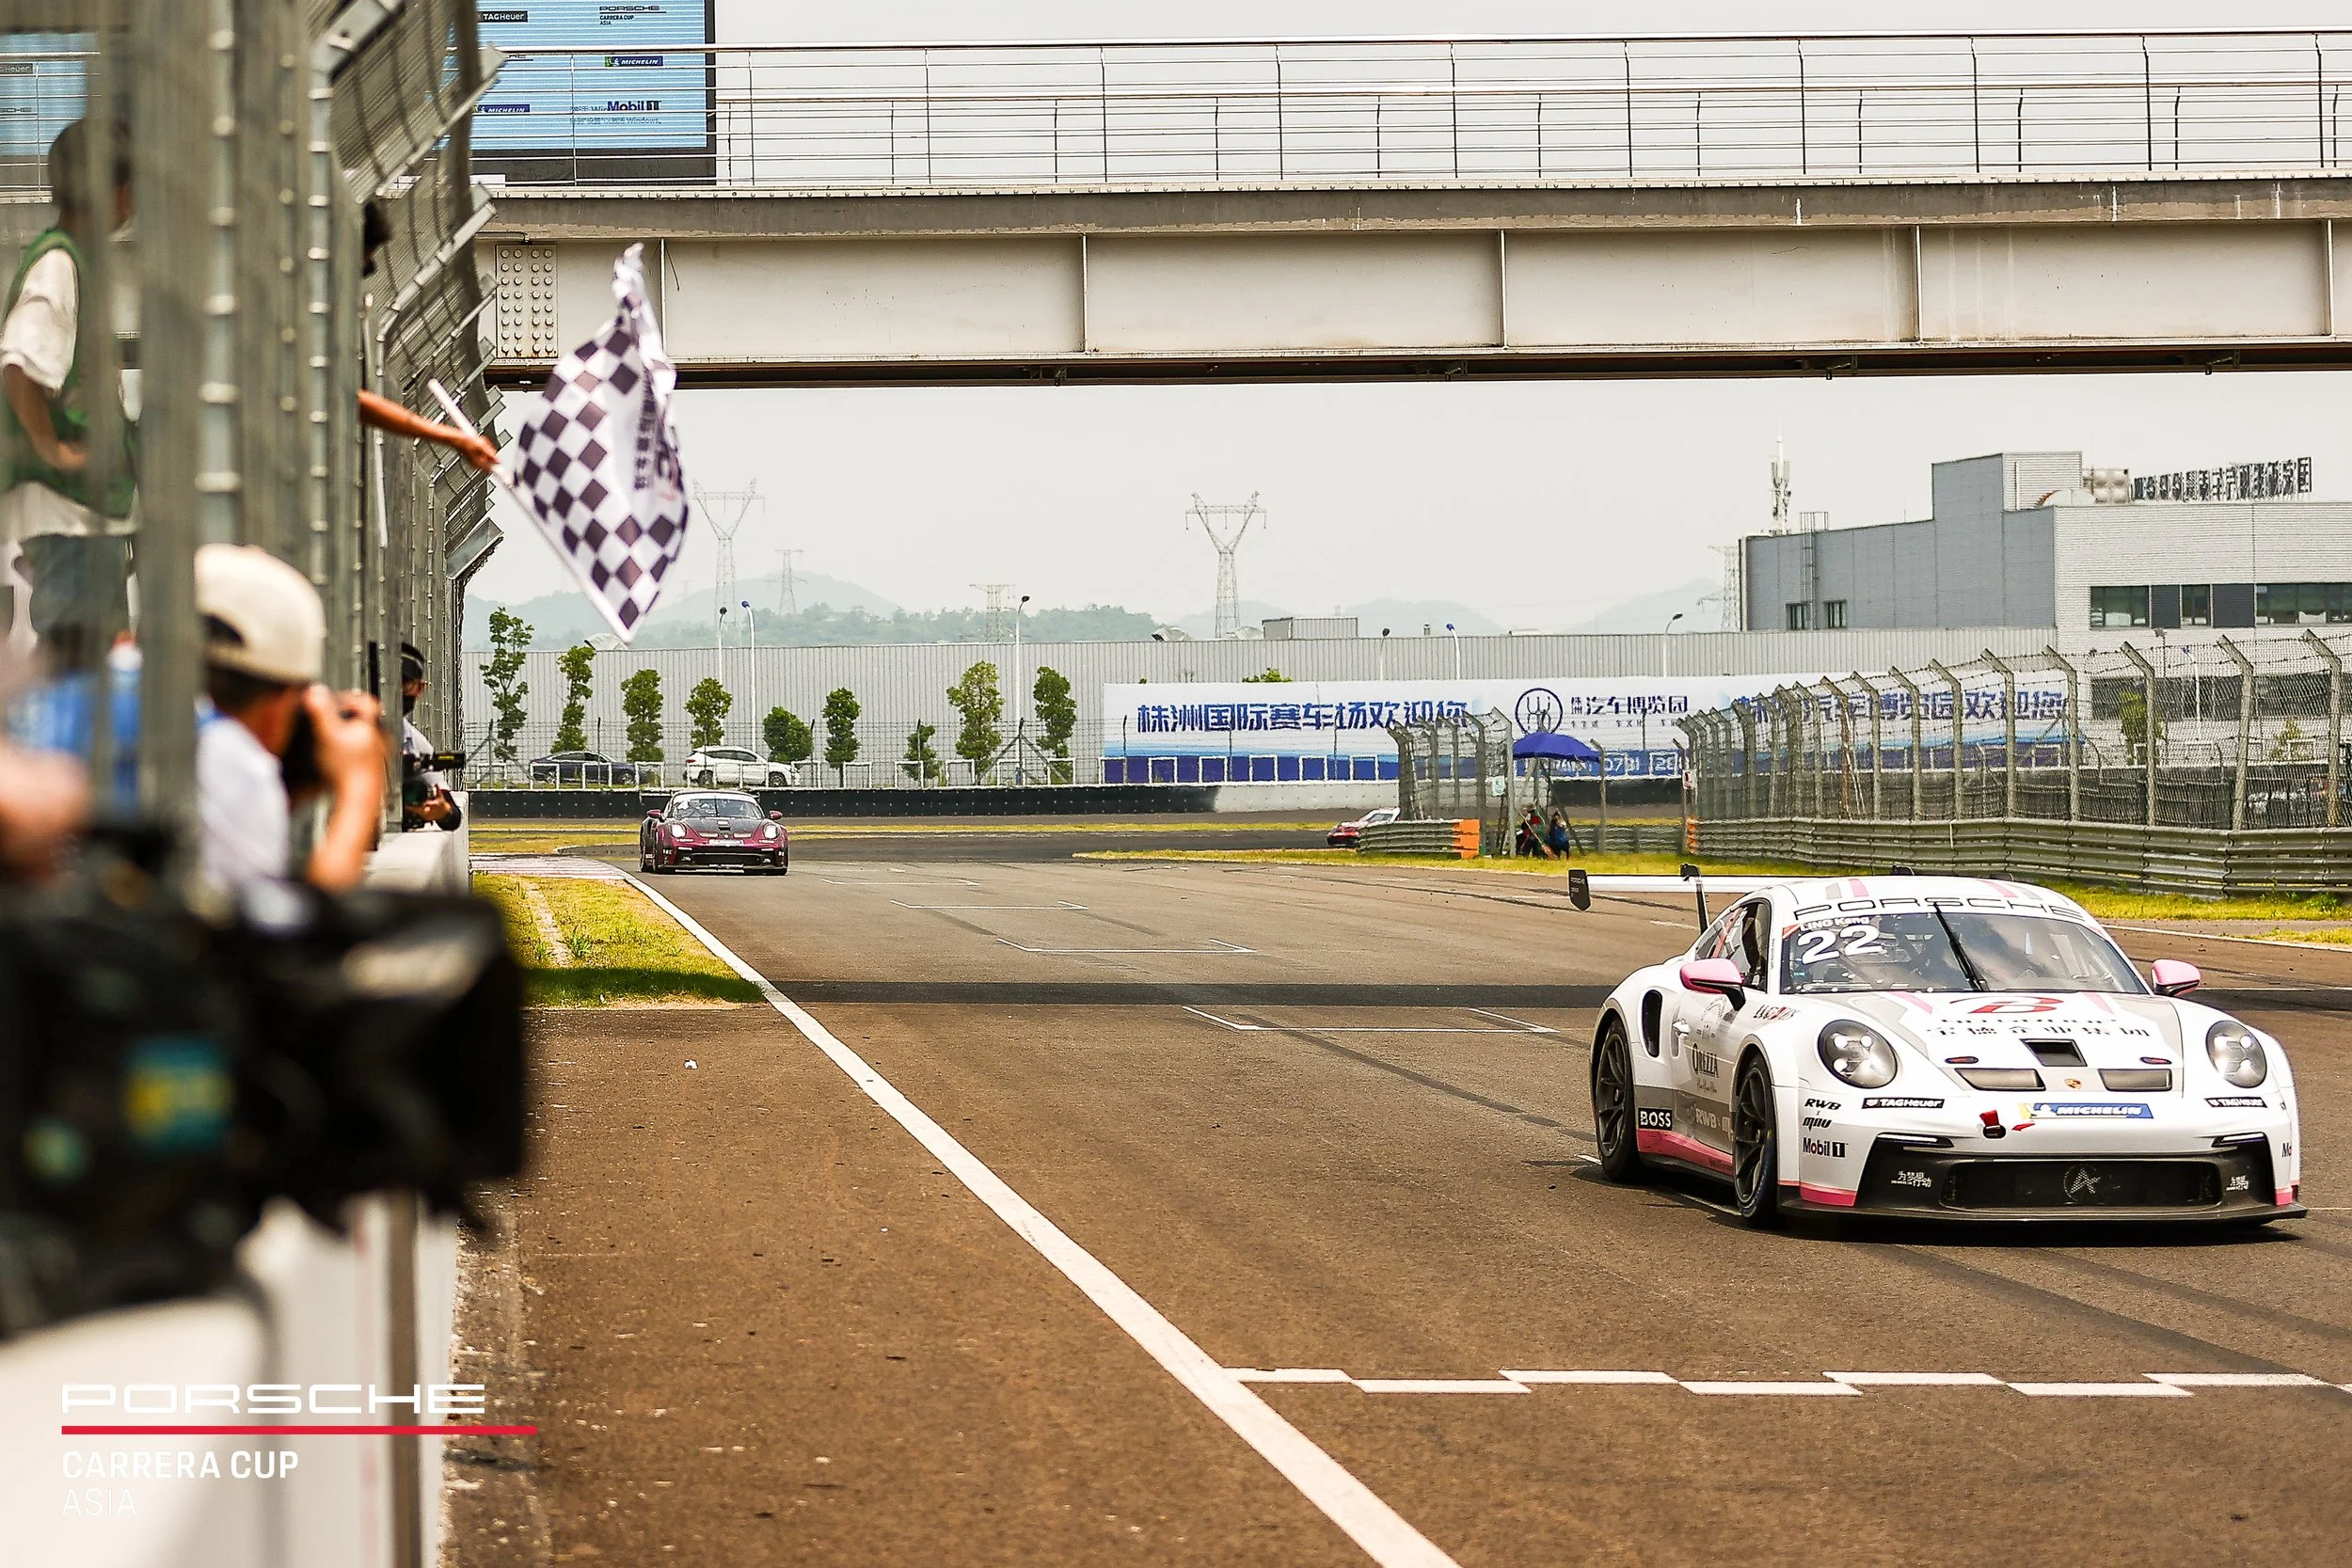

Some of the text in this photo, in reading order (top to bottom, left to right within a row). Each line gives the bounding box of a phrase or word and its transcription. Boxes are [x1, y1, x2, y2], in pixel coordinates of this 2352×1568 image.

[607, 101, 644, 111] Mobil
[646, 101, 659, 110] 1
[1137, 702, 1468, 733] 株洲国际赛车场欢迎您
[1794, 897, 2086, 922] PORSCHE
[1799, 920, 1835, 932] LING
[1797, 924, 1883, 966] 22
[1804, 1098, 1841, 1110] RWB
[1880, 1098, 1943, 1108] TAGHeuer
[2056, 1105, 2142, 1116] MICHELIN
[1640, 1110, 1672, 1128] BOSS
[1803, 1137, 1846, 1158] Mobil 1
